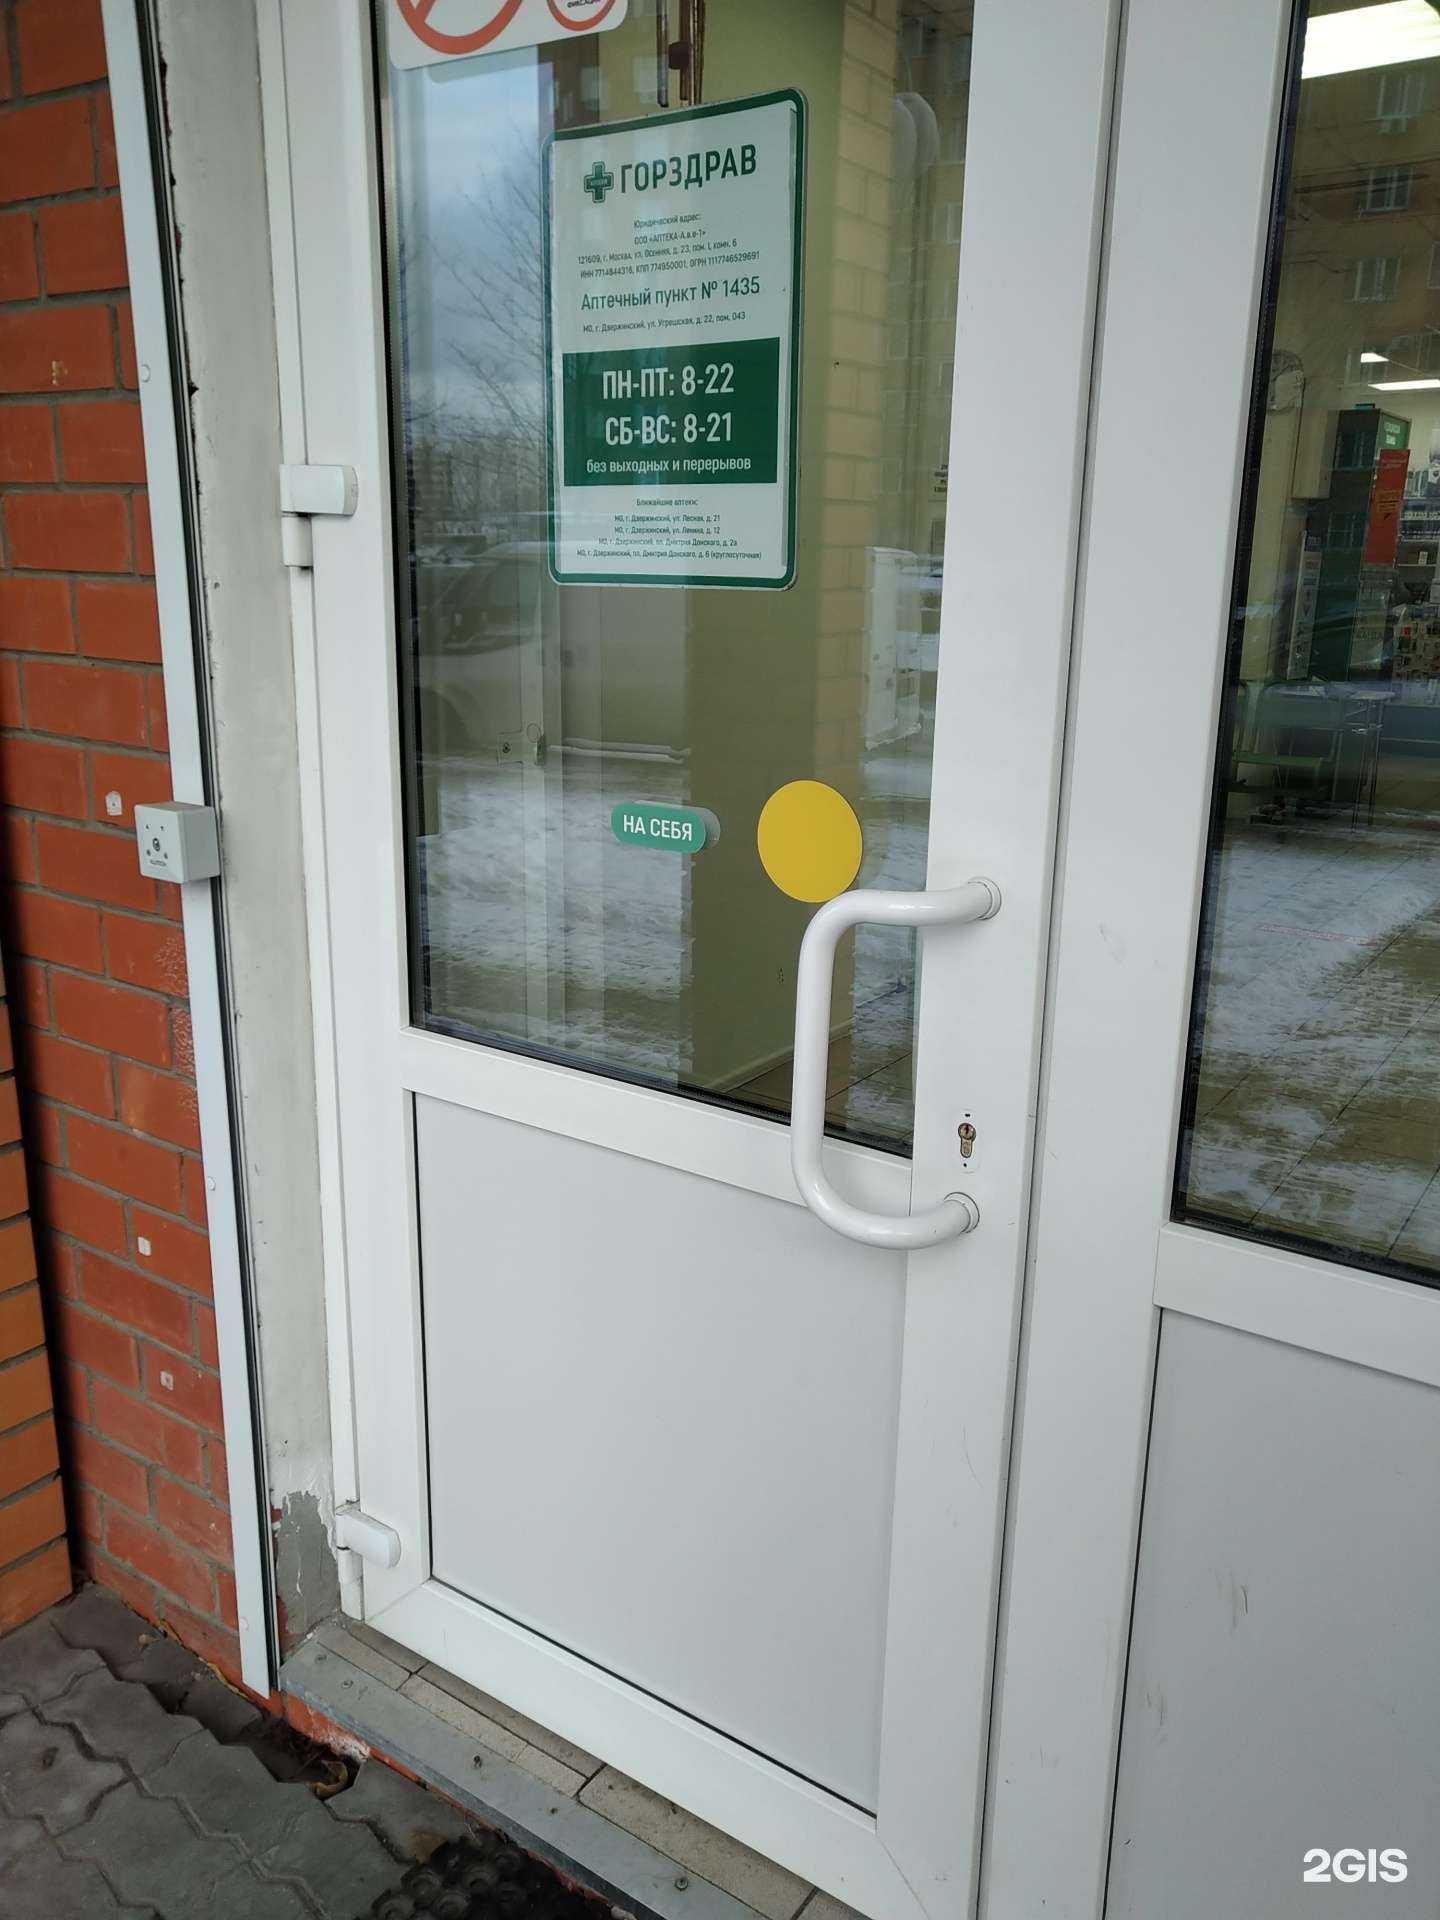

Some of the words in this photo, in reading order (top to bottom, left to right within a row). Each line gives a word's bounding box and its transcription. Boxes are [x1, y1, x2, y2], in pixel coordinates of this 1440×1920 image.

[620, 144, 757, 193] ГОРЗДРАВ
[635, 236, 648, 245] ООО
[580, 270, 594, 279] ИНН
[636, 264, 649, 273] КПП
[690, 258, 707, 268] ОГРН
[581, 288, 651, 310] Аптечный
[656, 287, 697, 307] пункт
[721, 276, 760, 297] 1435
[732, 311, 746, 320] 043
[603, 367, 674, 400] ПН-ПТ:
[681, 363, 735, 396] 8-22
[605, 415, 676, 446] СБ-ВС:
[683, 412, 731, 443] 8-21
[586, 459, 607, 473] без
[609, 459, 670, 474] выходных
[672, 460, 680, 471] и
[683, 457, 751, 474] перерывов
[623, 814, 647, 835] НА
[650, 818, 693, 841] СЕБЯ
